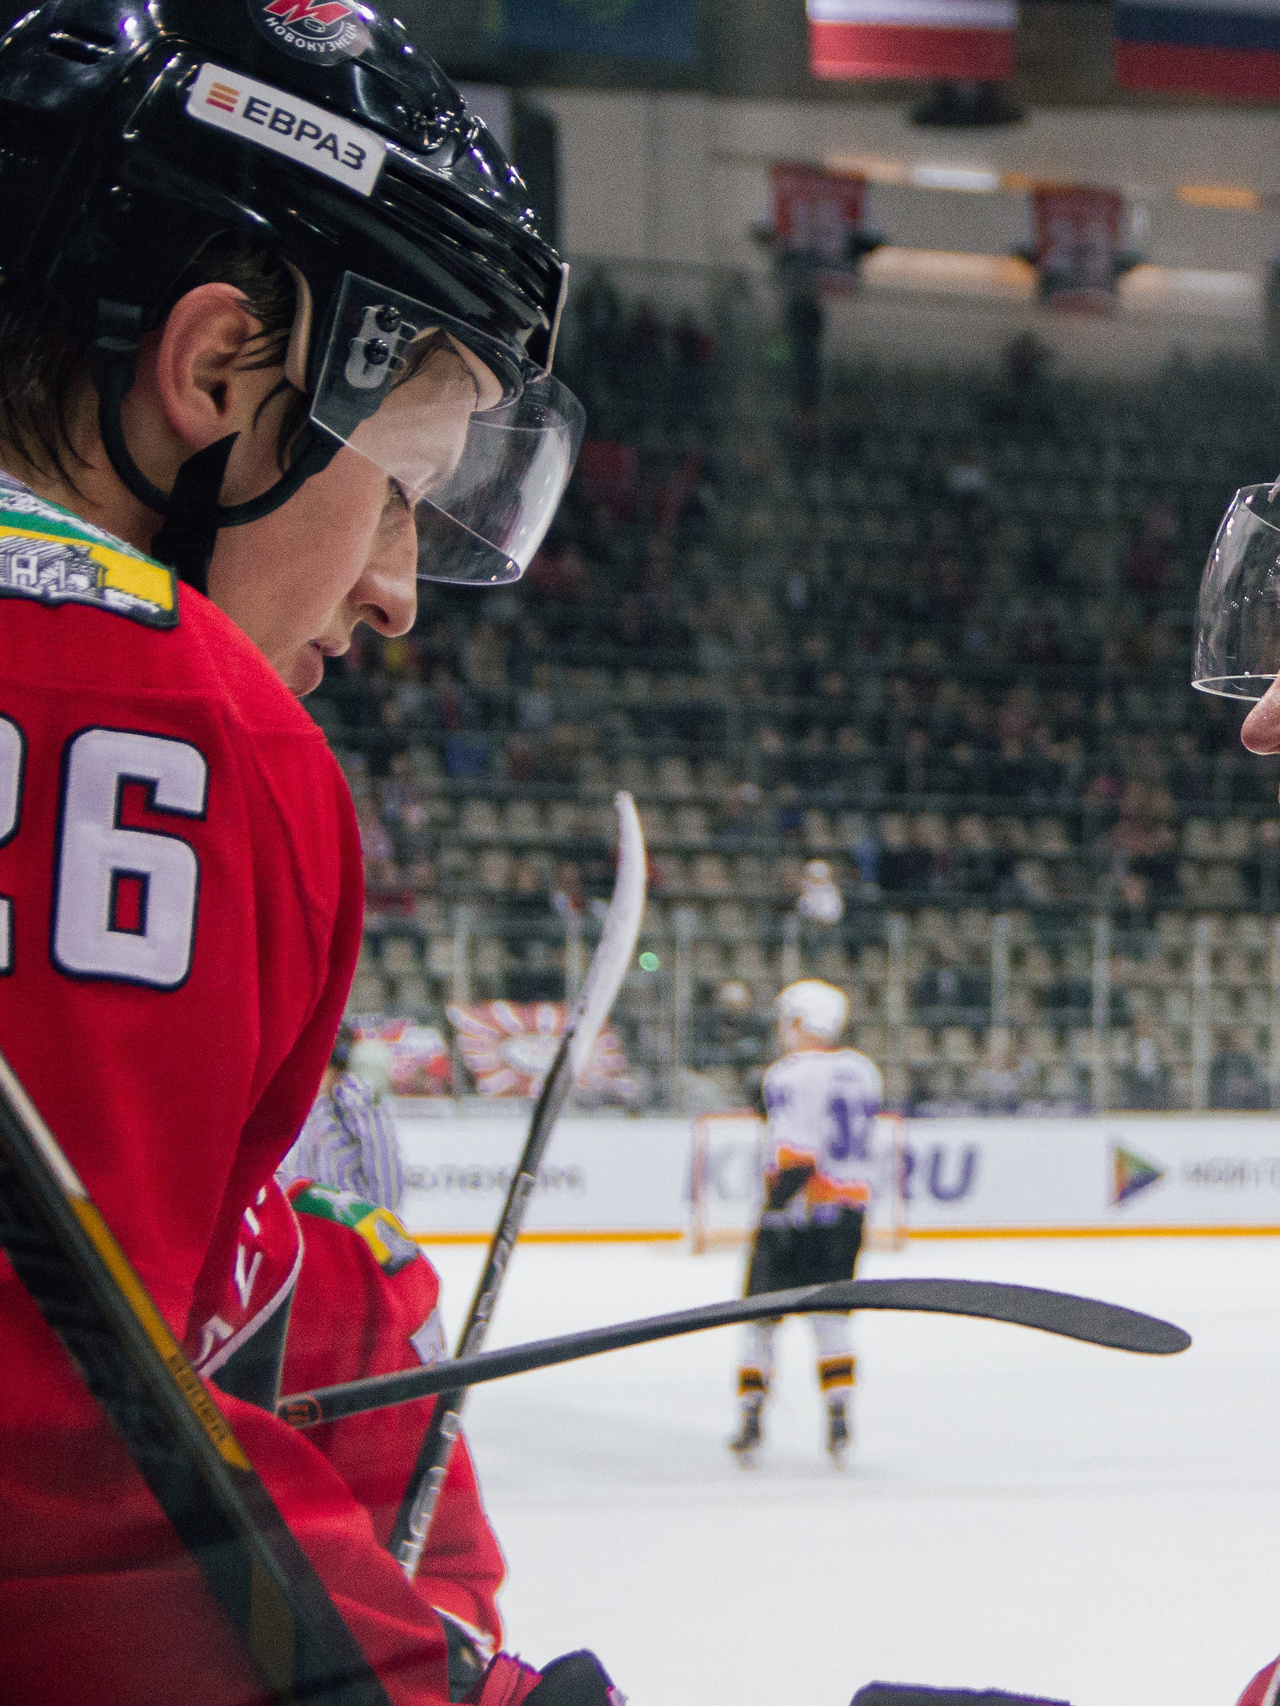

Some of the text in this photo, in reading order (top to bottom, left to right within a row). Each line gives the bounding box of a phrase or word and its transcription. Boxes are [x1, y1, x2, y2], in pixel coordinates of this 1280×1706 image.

[264, 17, 358, 53] НОВОКУЗНЕЦК
[242, 95, 367, 171] ЕВРАЗ
[0, 710, 210, 993] 6
